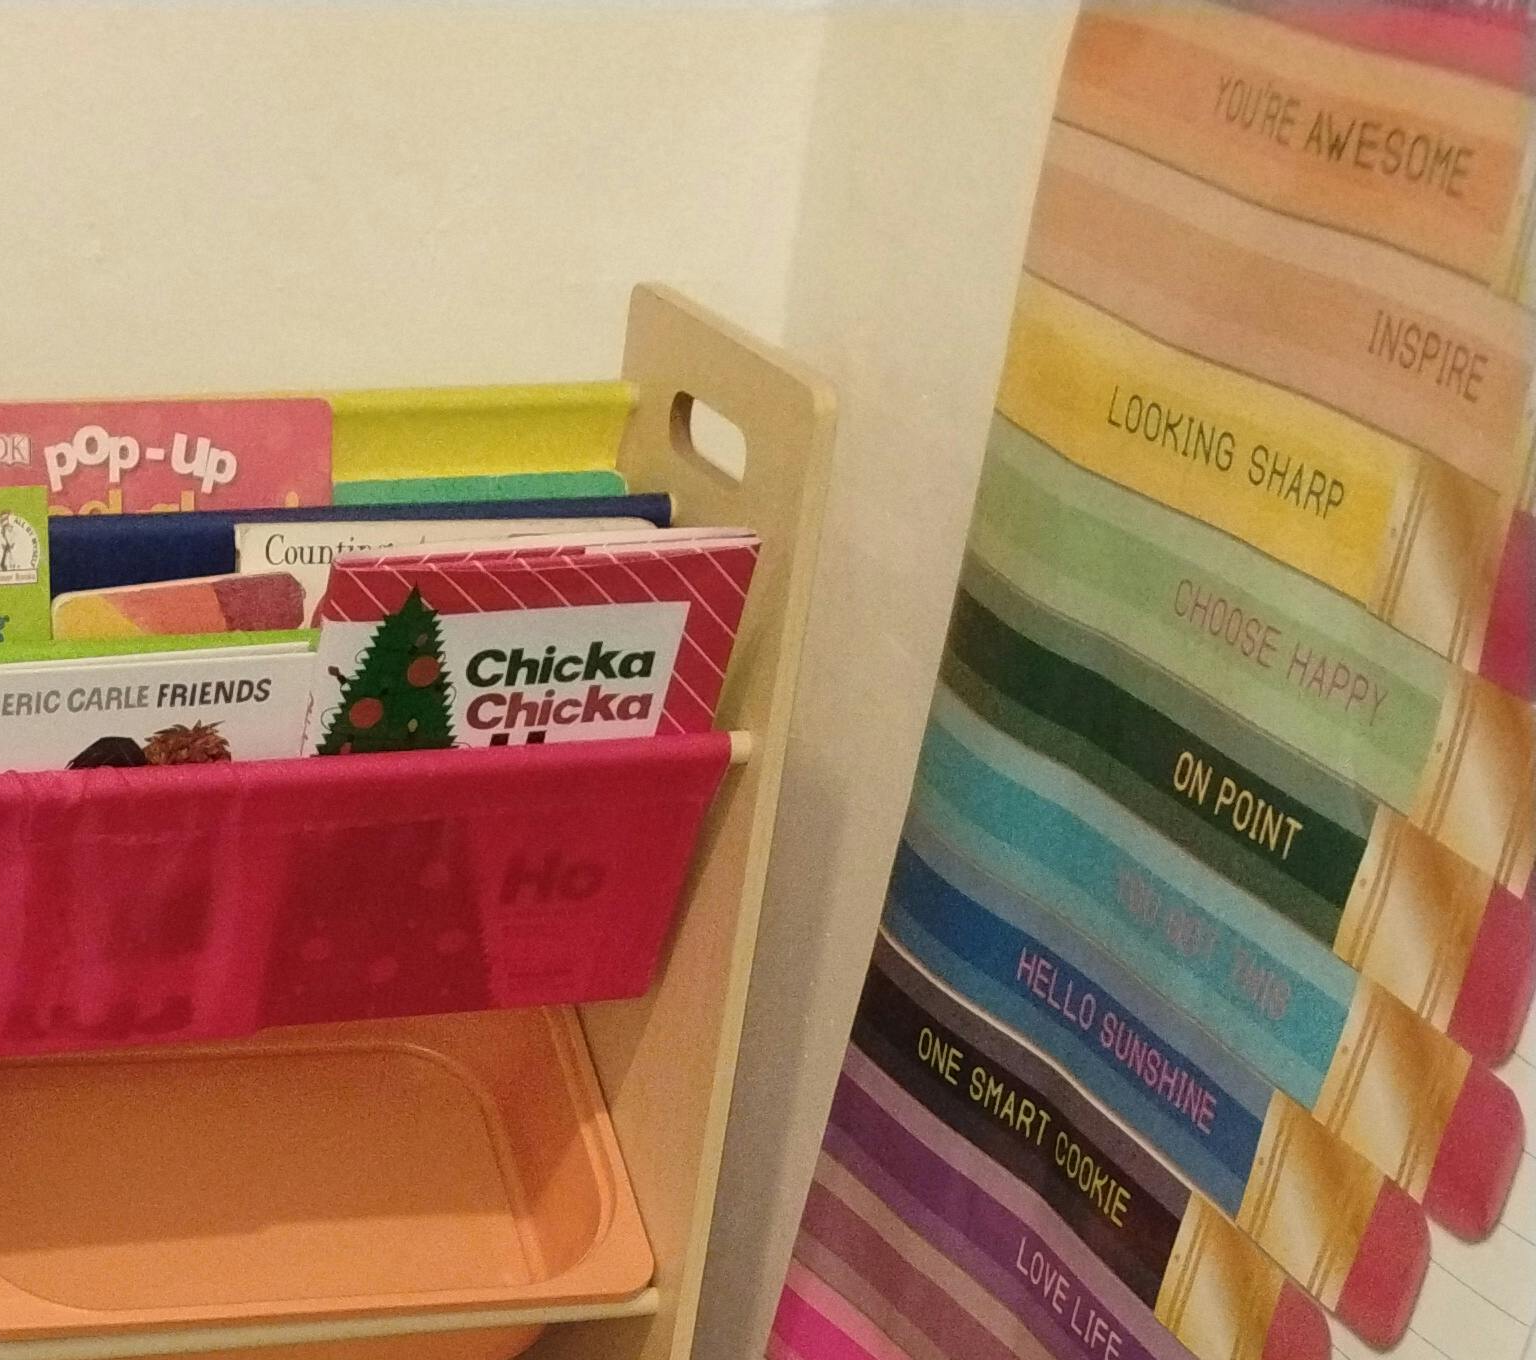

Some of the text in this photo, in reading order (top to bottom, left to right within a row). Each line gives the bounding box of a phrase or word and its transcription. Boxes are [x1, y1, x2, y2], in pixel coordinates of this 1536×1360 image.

[1216, 75, 1473, 199] YOU'RE AWESOME
[1367, 310, 1488, 403] INSPIRE
[44, 425, 237, 492] pop-up
[1107, 385, 1344, 519] LOOKING SHARP
[1, 678, 272, 717] ERIC CARLE FRIENDS
[466, 641, 655, 688] Chicka
[1175, 579, 1388, 727] CHOOSE HAPPY
[466, 685, 652, 731] Chicka
[1173, 751, 1303, 861] ON POINT
[1018, 947, 1216, 1134] HELLO SUNSHINE
[918, 1027, 1131, 1228] ONE SMART COOKIE
[1016, 1237, 1069, 1314] LOVE
